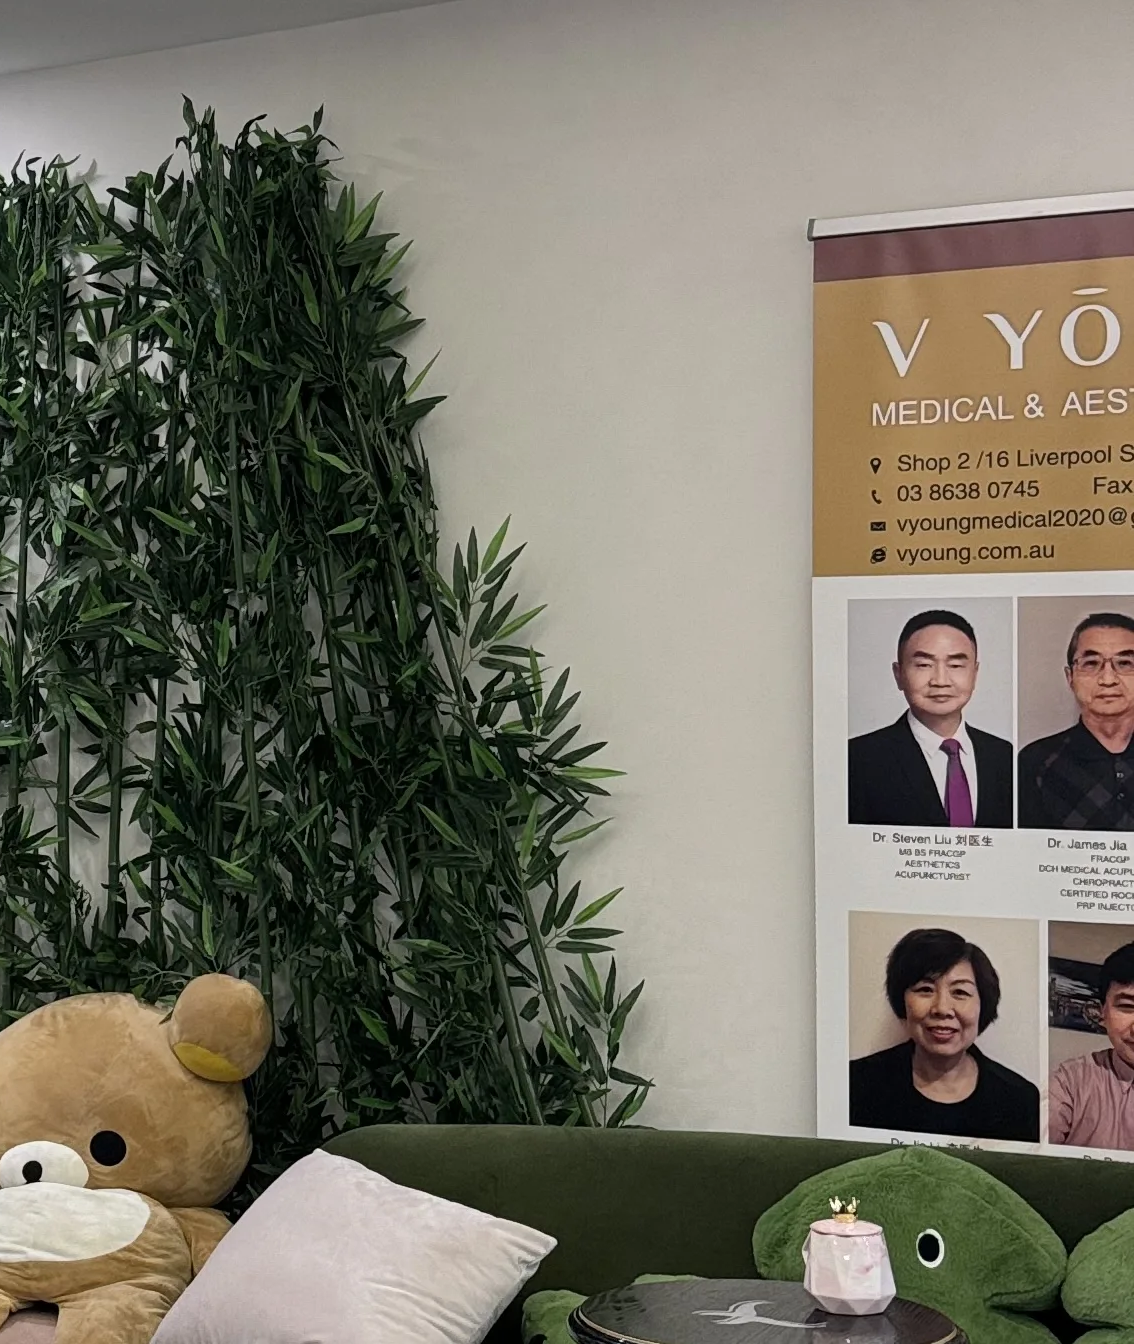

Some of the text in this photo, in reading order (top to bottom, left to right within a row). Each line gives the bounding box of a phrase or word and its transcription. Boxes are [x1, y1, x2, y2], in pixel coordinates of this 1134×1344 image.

[872, 318, 930, 378] V
[871, 395, 1015, 427] MEDICAL
[1023, 393, 1044, 418] &
[897, 454, 951, 474] Shop
[958, 452, 970, 469] 2
[976, 450, 1010, 470] /16
[1017, 445, 1112, 469] Liverpool
[897, 484, 922, 502] 03
[929, 482, 981, 501] 8638
[988, 480, 1039, 499] 0745
[897, 542, 1055, 566] vyoung.com.au
[892, 833, 931, 844] Steven
[934, 834, 952, 845] Liu
[955, 834, 993, 847] 刘医生
[1067, 838, 1106, 851] James
[1109, 840, 1127, 851] Jia
[905, 860, 961, 869] AESTHETICS
[1039, 864, 1059, 873] DCH
[1061, 865, 1100, 875] MEDICAL
[894, 870, 971, 881] ACUPUNCTURIST
[1060, 889, 1109, 899] CERTIFIED
[1076, 901, 1095, 910] PRP
